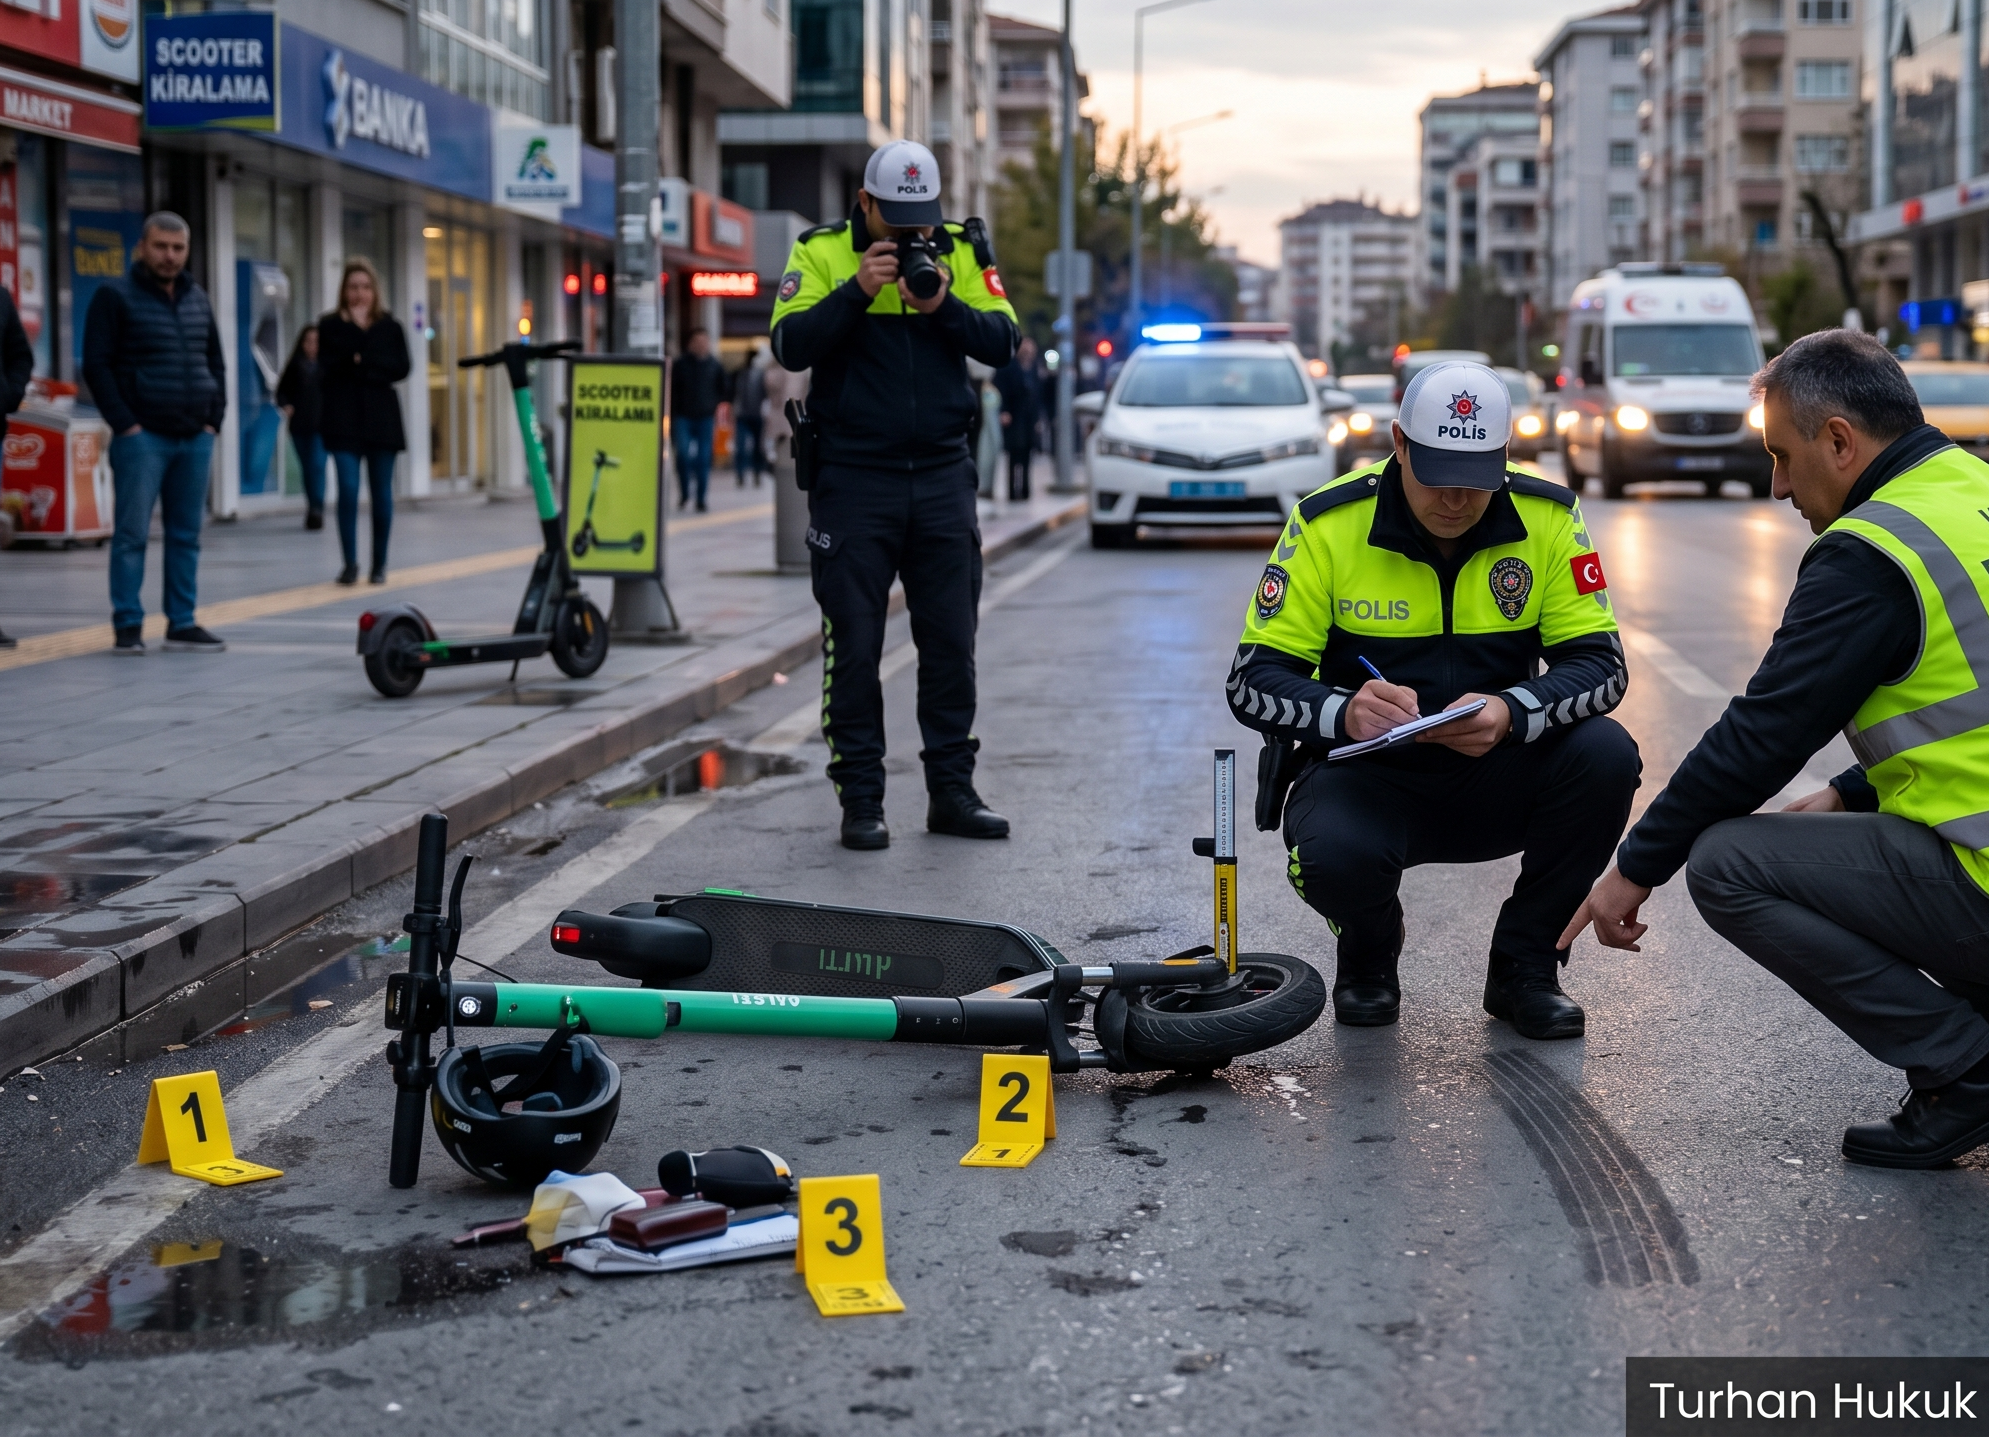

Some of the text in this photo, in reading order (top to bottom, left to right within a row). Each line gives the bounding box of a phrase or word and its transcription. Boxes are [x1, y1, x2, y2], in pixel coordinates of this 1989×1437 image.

[156, 37, 264, 68] SCOOTER
[150, 68, 270, 104] KİRALAMA
[3, 88, 73, 131] MARKET
[352, 76, 431, 160] BANKA
[578, 383, 652, 401] SCOOTER
[1437, 424, 1487, 440] POLİS
[1338, 598, 1410, 621] POLIS
[994, 1071, 1031, 1123] 2
[180, 1091, 208, 1144] 1
[824, 1196, 863, 1257] 3
